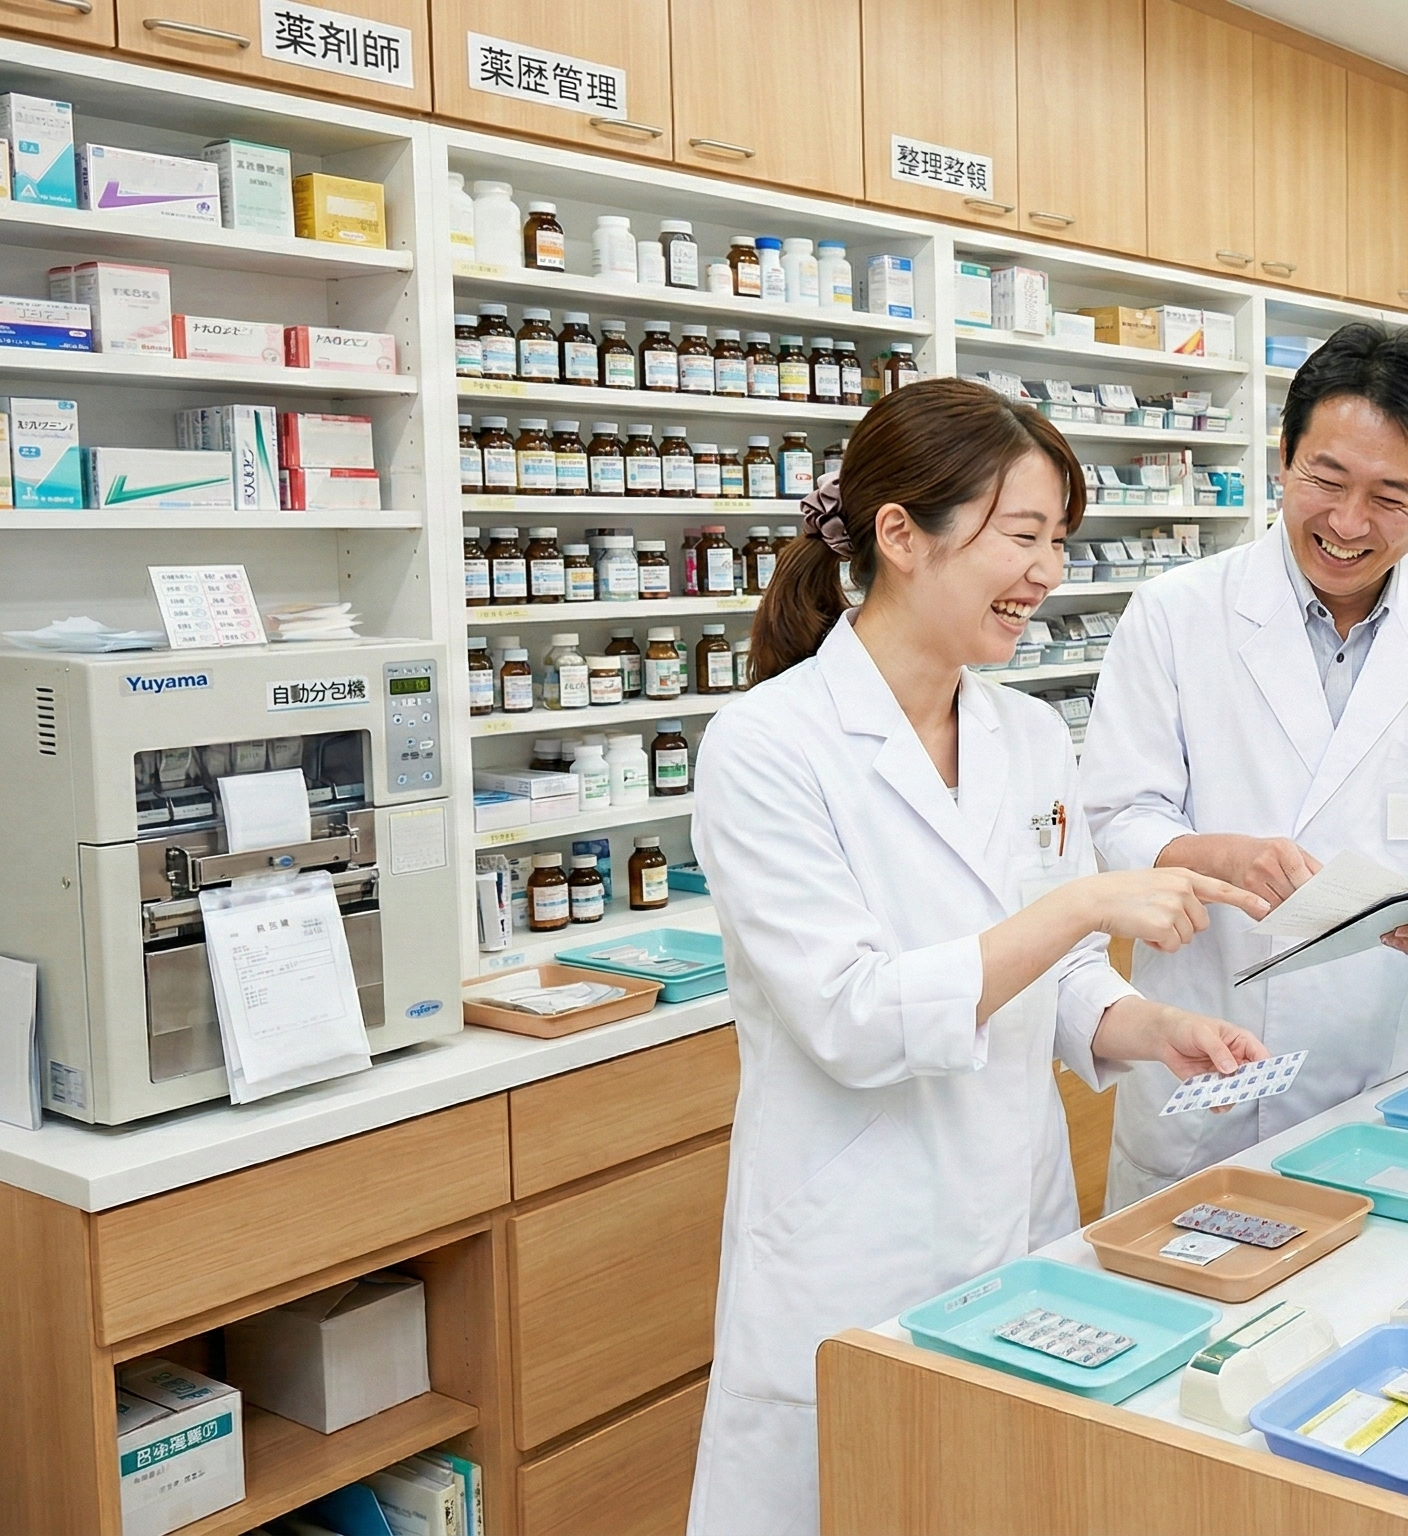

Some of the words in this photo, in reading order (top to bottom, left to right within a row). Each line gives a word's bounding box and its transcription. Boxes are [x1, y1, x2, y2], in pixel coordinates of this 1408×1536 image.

[275, 11, 400, 73] 薬剤師
[480, 46, 618, 110] 薬歴管理
[126, 674, 208, 693] Yuyama
